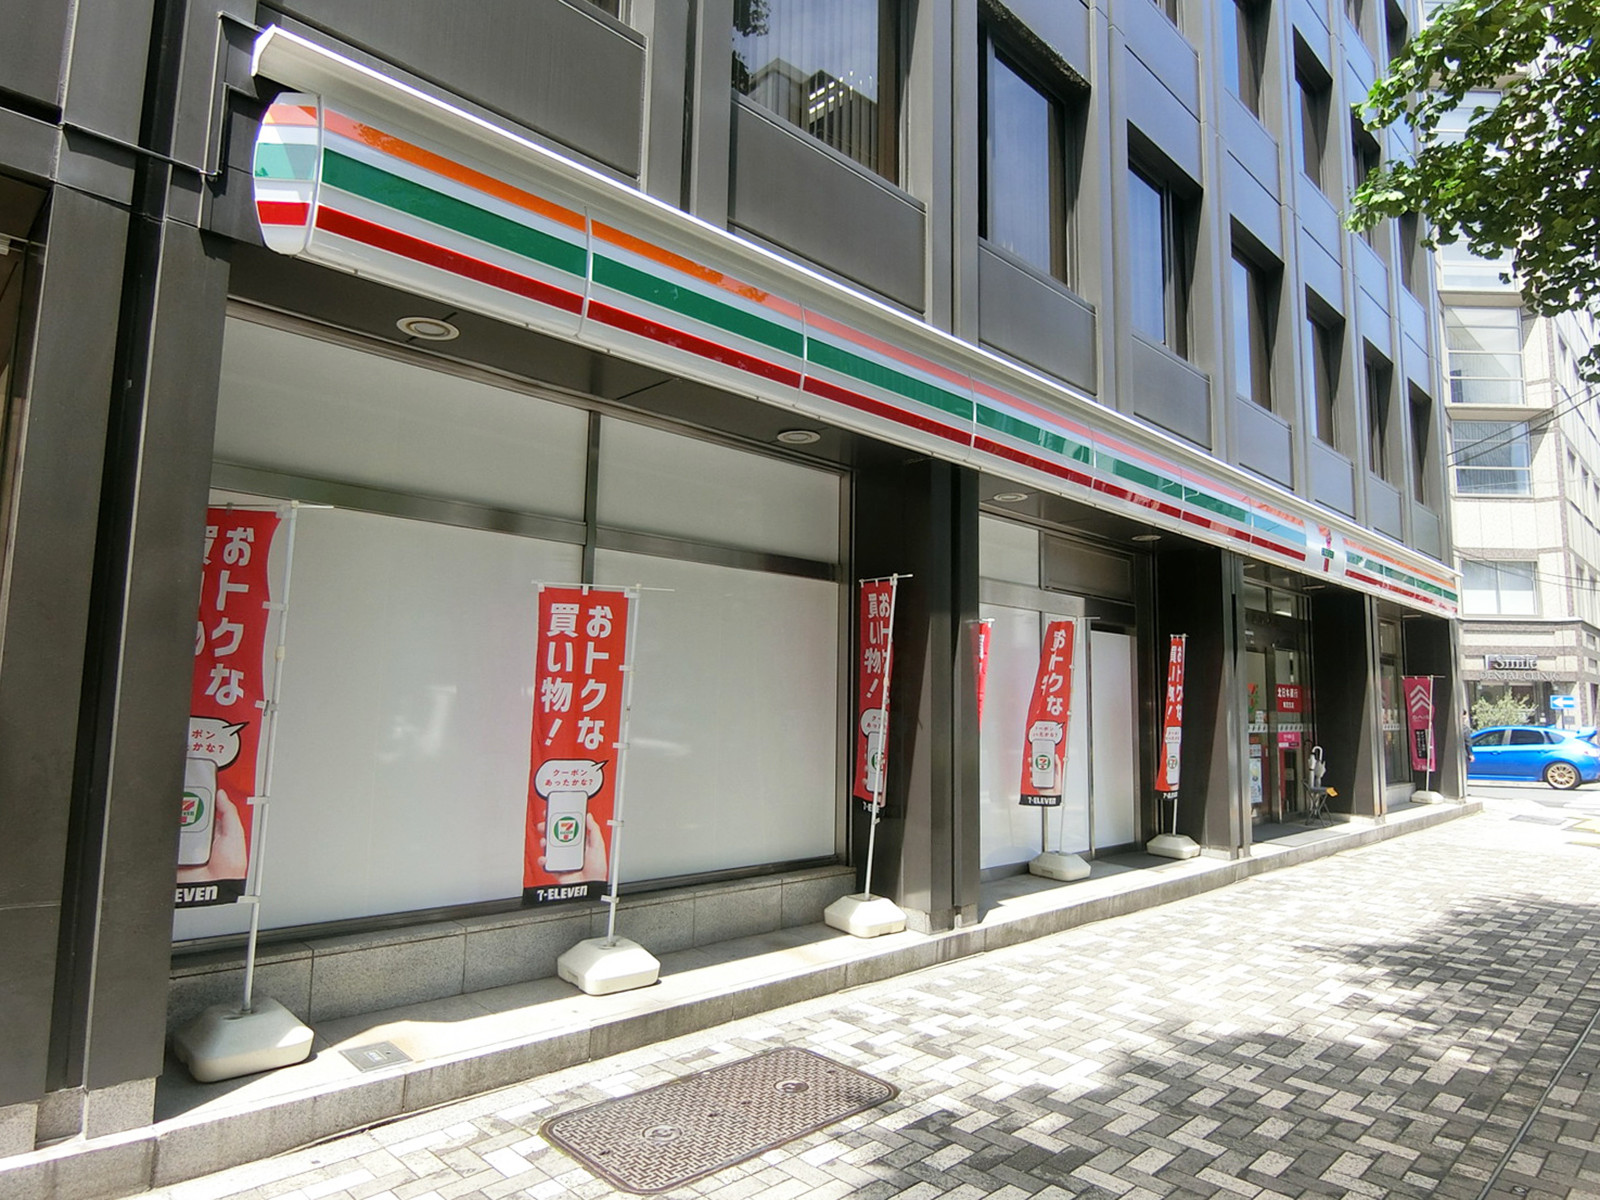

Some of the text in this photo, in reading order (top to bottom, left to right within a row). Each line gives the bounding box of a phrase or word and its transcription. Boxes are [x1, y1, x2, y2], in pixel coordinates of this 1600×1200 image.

[205, 526, 255, 706] おトクな
[541, 603, 580, 747] 買い物！
[577, 605, 613, 750] おトクな
[1046, 628, 1068, 715] おトクな
[1479, 671, 1561, 682] DENTAL CLINIC
[544, 778, 594, 787] あったかな？
[552, 768, 588, 777] クーポン
